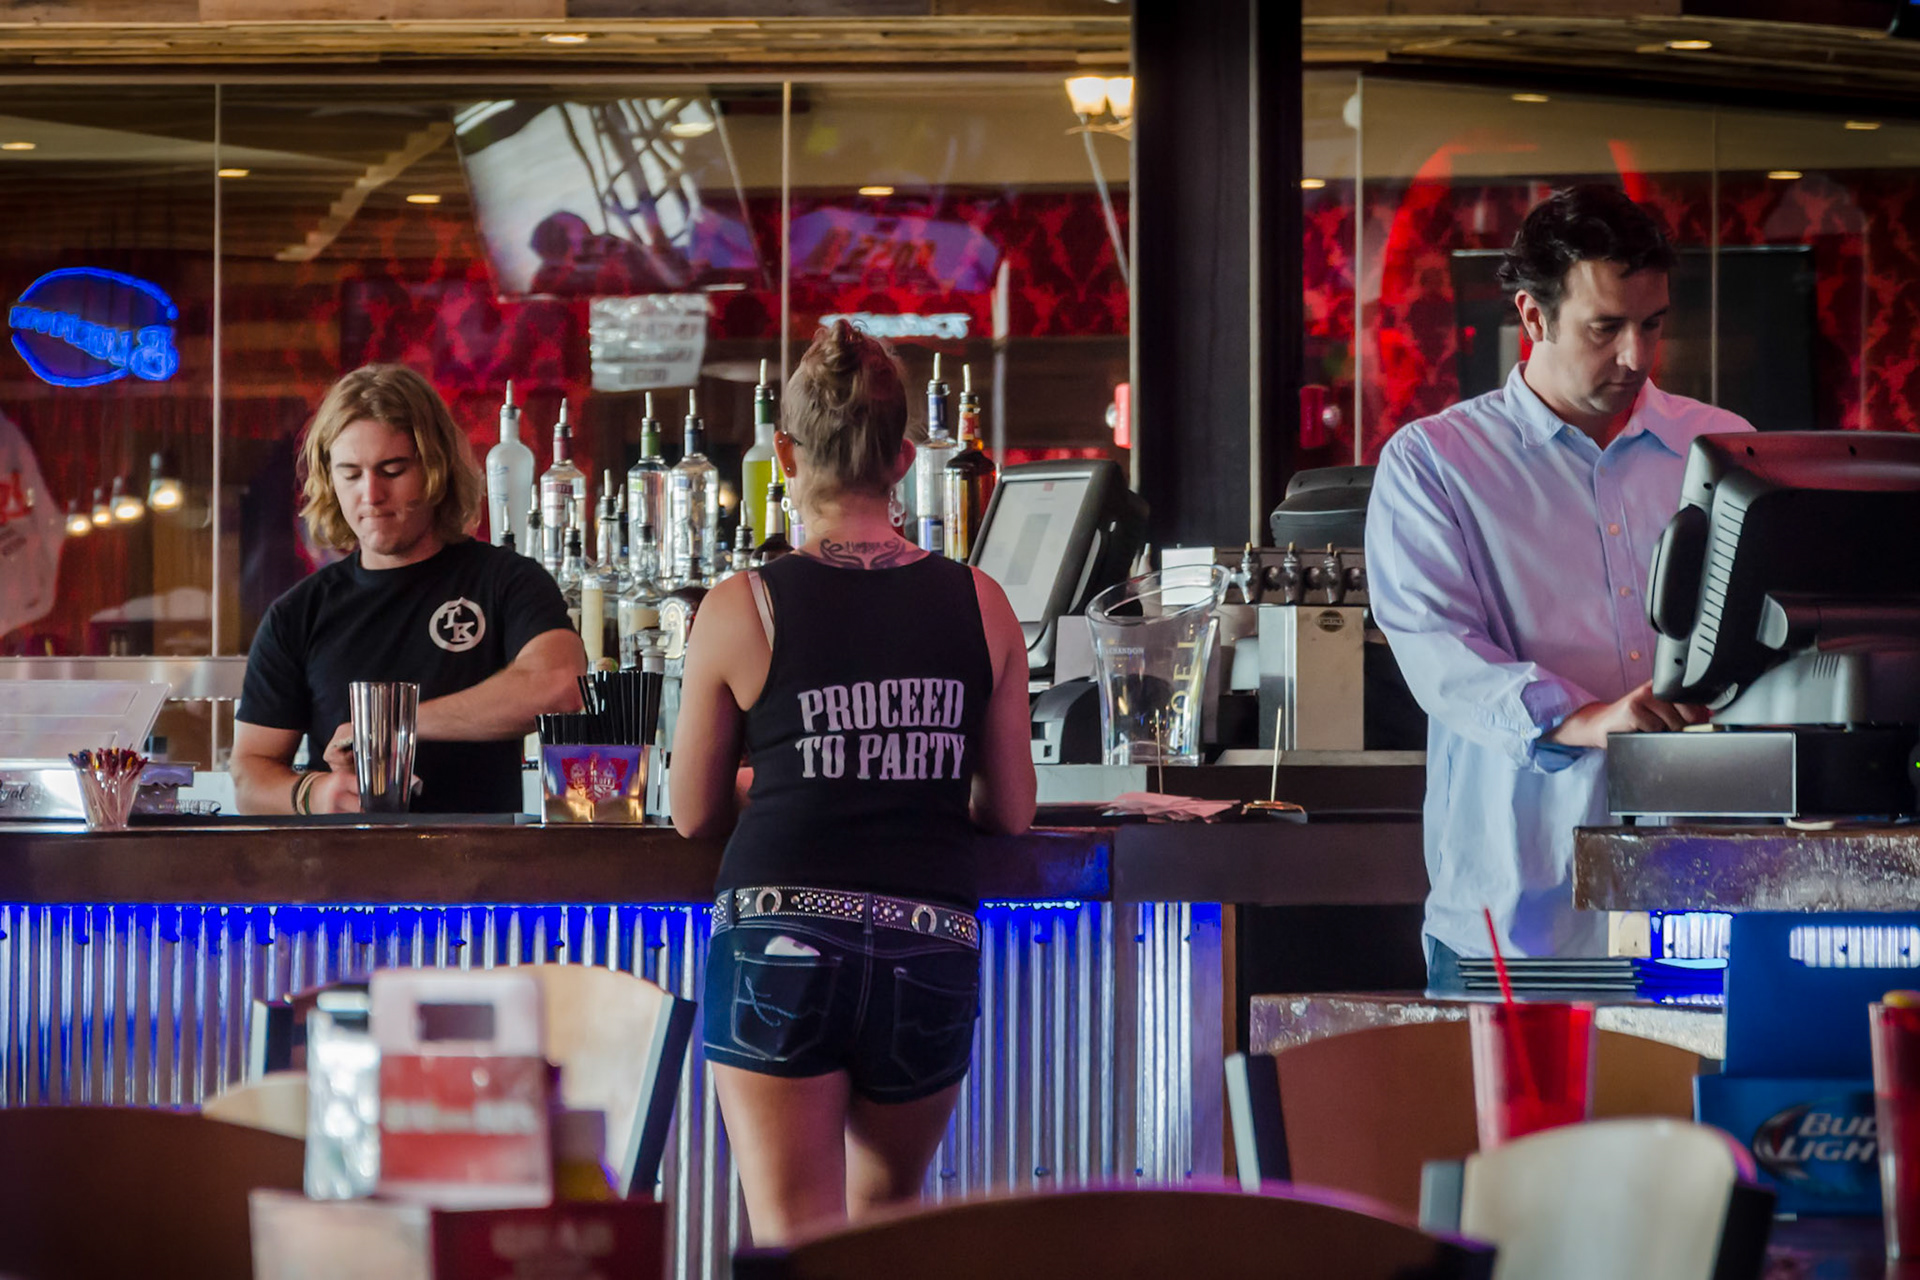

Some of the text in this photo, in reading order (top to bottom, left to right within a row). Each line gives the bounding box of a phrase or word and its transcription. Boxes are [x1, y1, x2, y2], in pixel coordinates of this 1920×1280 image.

[797, 677, 965, 733] PROCEED
[795, 731, 966, 780] TO PARTY
[1777, 1136, 1877, 1163] LIGH
